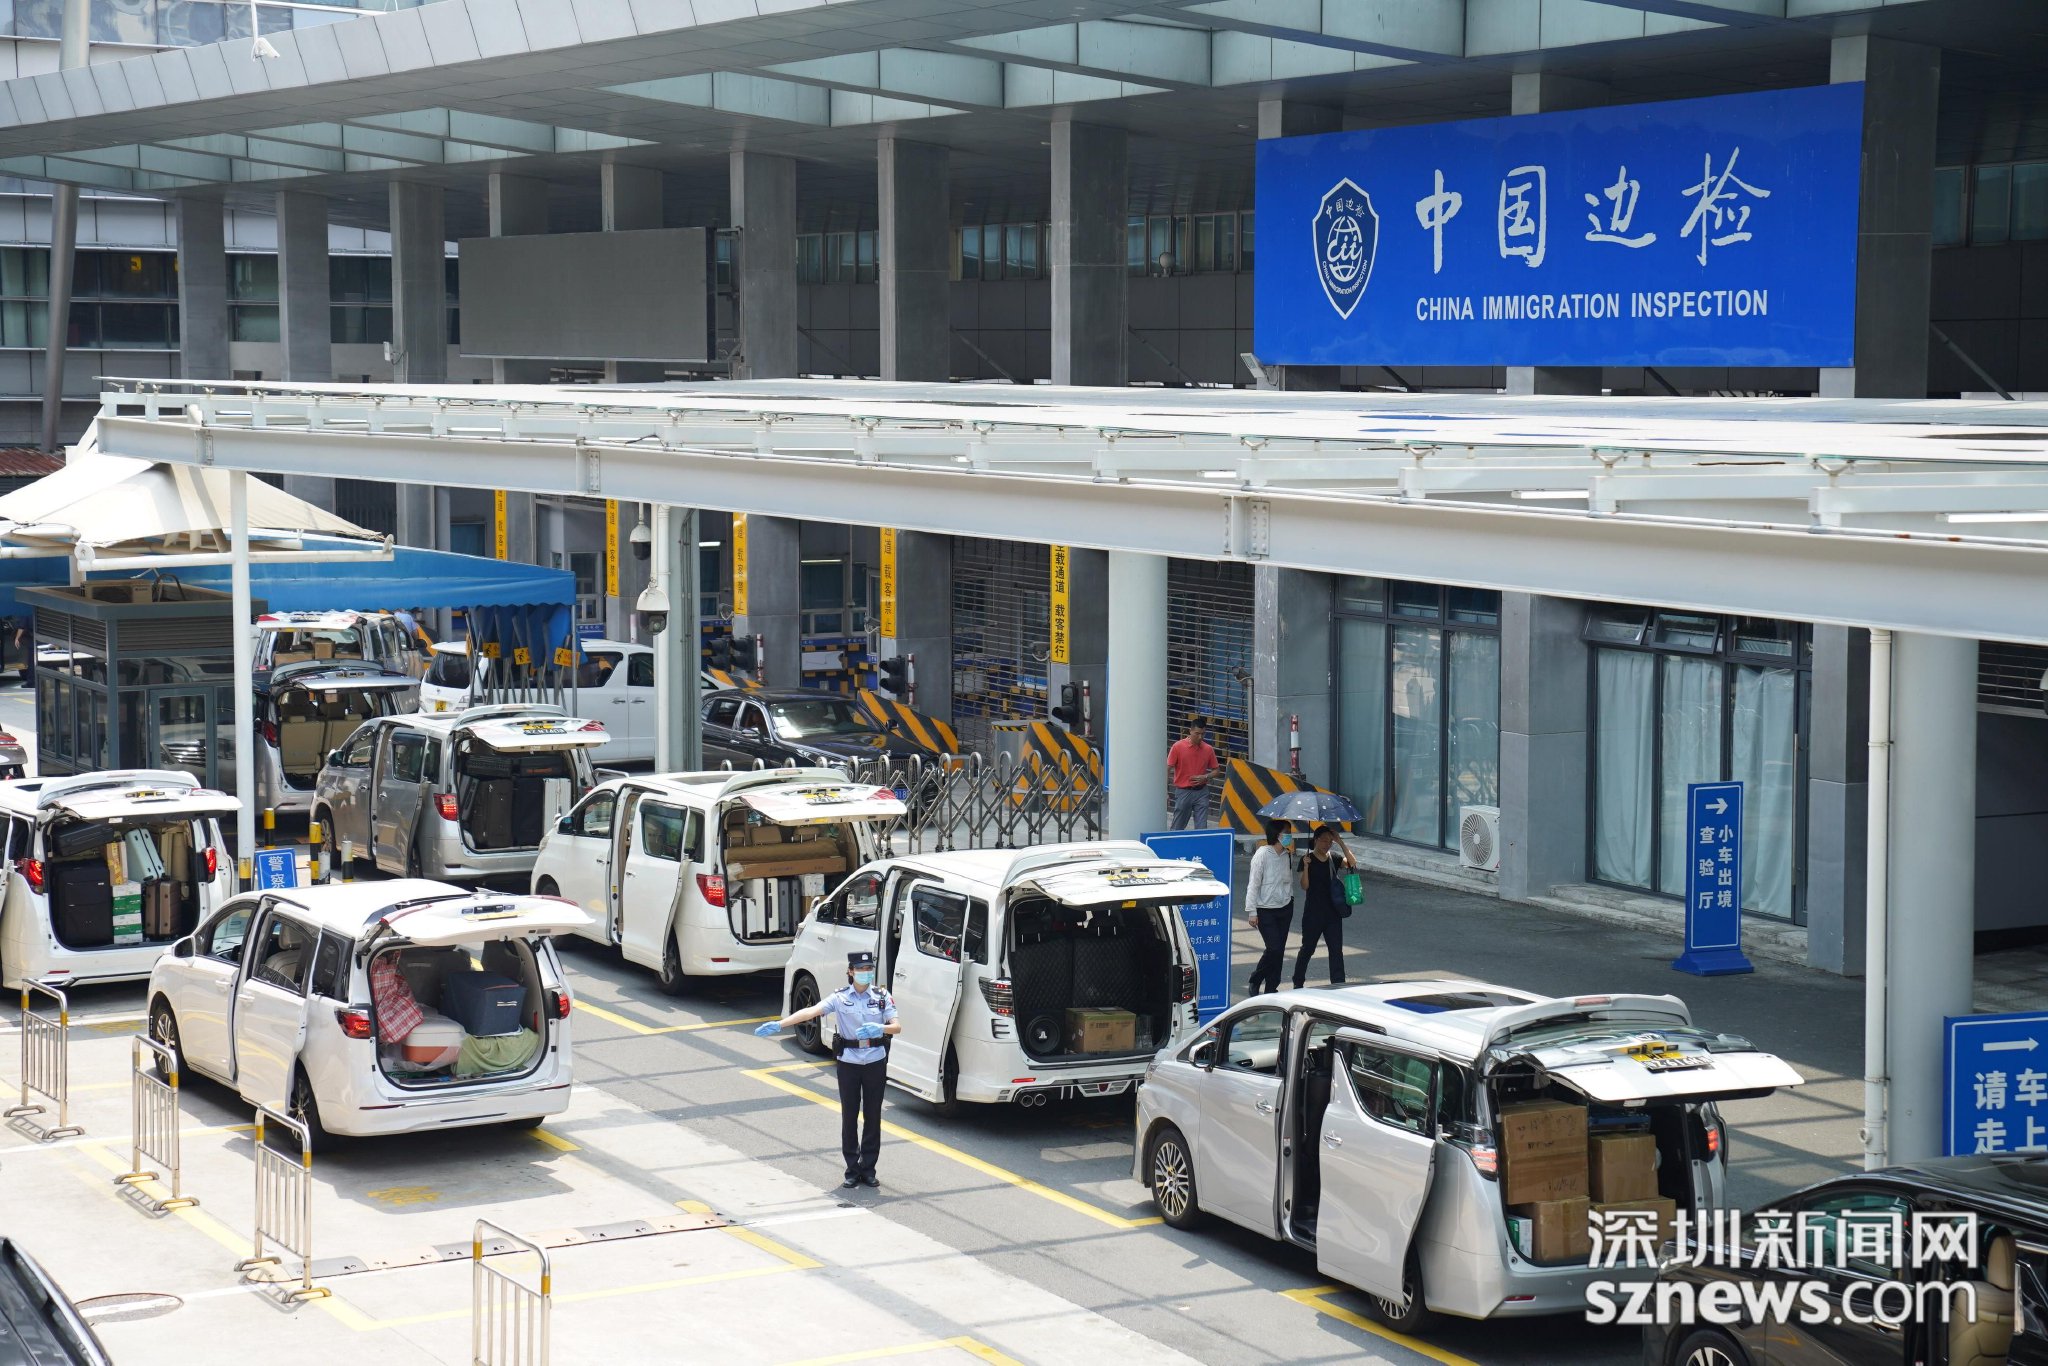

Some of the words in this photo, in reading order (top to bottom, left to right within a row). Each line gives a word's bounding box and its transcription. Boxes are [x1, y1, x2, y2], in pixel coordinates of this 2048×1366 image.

[1415, 146, 1770, 274] 中国边检
[1417, 297, 1475, 322] CHINA
[1482, 293, 1620, 320] IMMIGRATION
[1631, 289, 1769, 318] INSPECTION
[1055, 604, 1065, 658] 载客禁行
[268, 856, 285, 888] 警察
[1699, 826, 1714, 909] 查验厅
[1718, 825, 1733, 908] 小车出境
